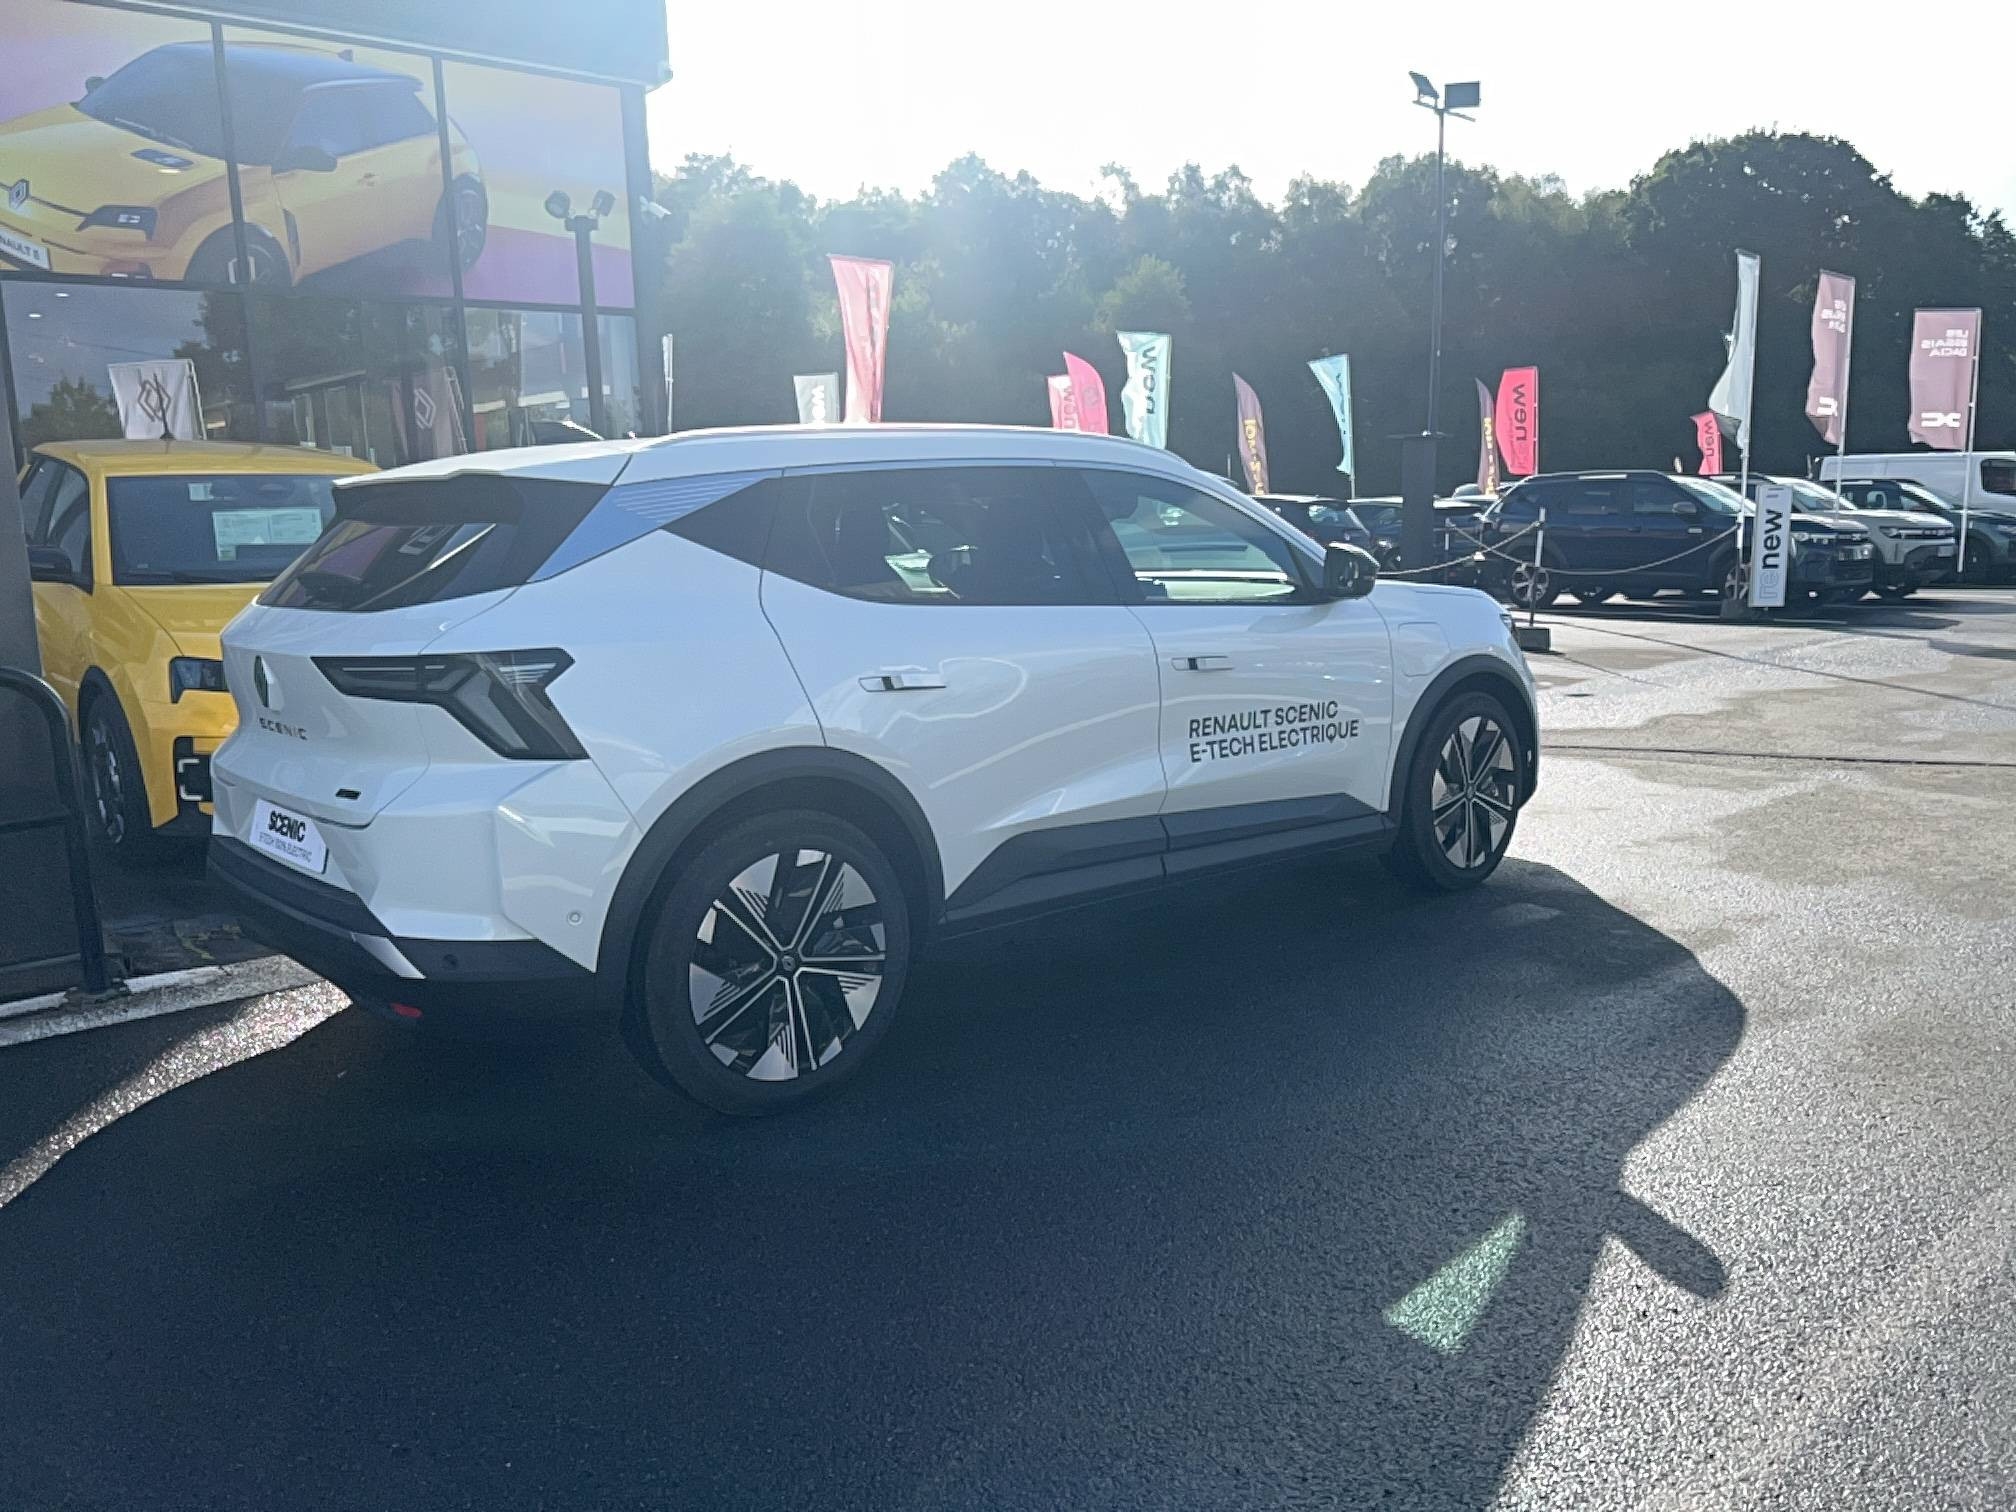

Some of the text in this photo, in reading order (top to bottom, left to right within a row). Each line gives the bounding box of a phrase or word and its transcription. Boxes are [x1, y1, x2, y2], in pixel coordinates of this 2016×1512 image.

[259, 717, 308, 740] SCENIC
[1189, 701, 1338, 739] RENAULT SCENIC
[1189, 719, 1360, 763] E-TECH ELECTRIQUE
[268, 810, 307, 843] SCENIC
